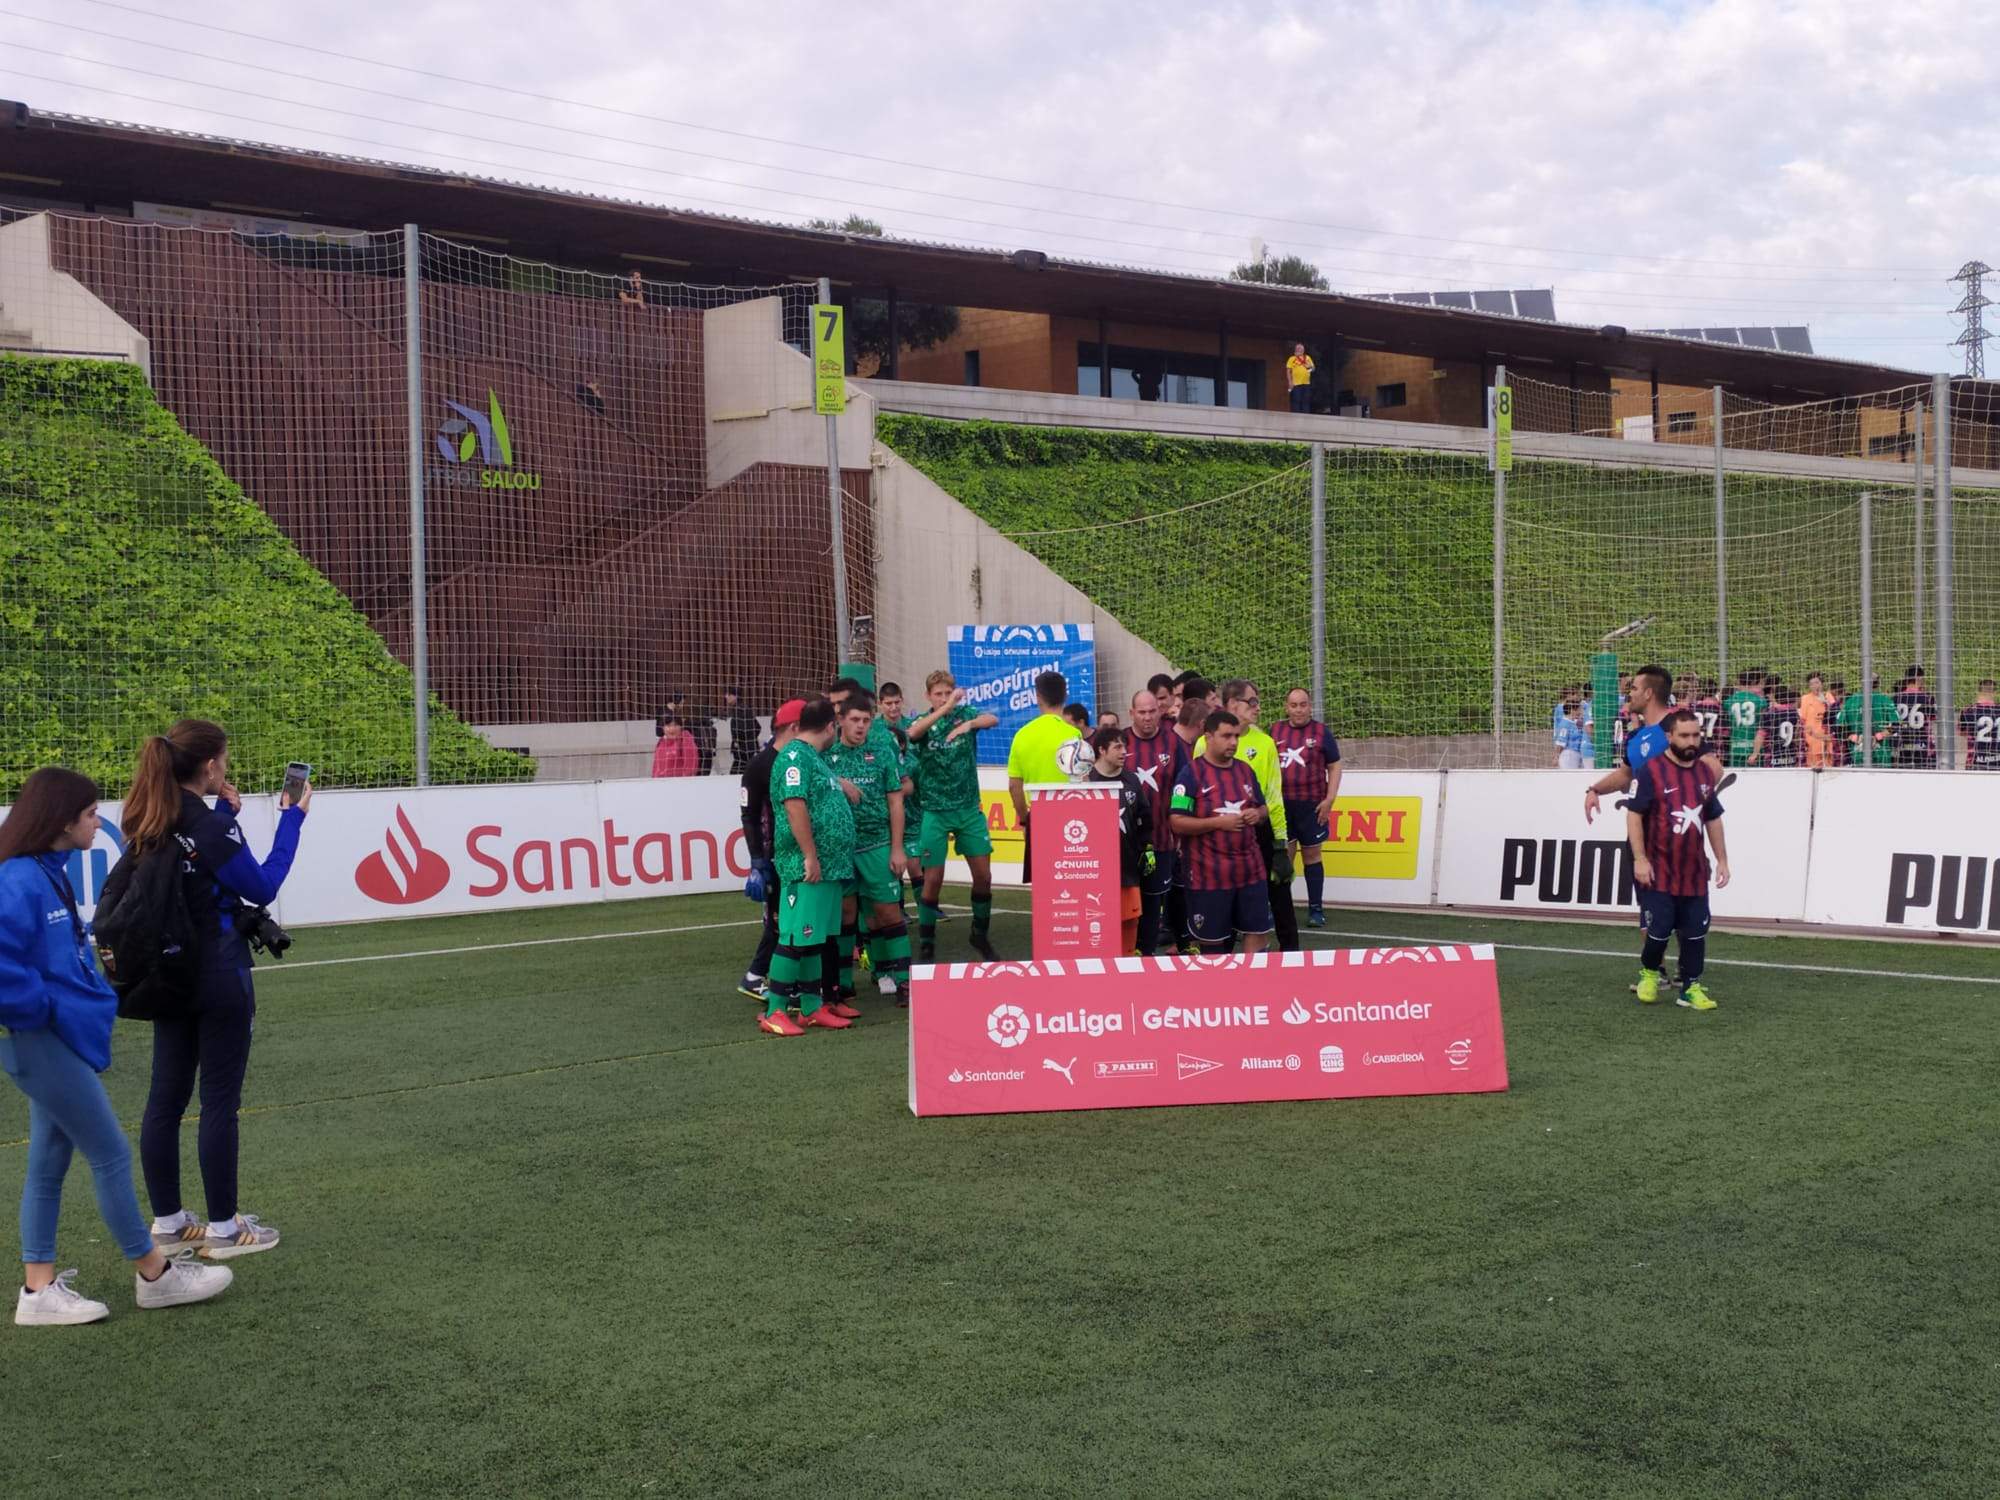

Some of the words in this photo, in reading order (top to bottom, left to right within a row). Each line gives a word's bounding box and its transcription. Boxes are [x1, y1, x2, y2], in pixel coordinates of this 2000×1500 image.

[819, 310, 838, 341] 7
[1500, 391, 1510, 415] 8
[481, 470, 541, 490] SALOU
[1731, 701, 1756, 728] 13
[1780, 721, 1794, 747] 9
[1328, 810, 1407, 843] INI
[466, 818, 752, 898] Santan
[1064, 845, 1088, 853] LaLiga
[1054, 860, 1099, 869] GENUINE
[1063, 872, 1099, 880] Santander
[1500, 838, 1635, 906] PUM
[1035, 1008, 1123, 1037] LaLiga
[1142, 1005, 1270, 1031] GENUINE
[1314, 1000, 1433, 1025] Santander
[965, 1068, 1025, 1082] Santander
[1111, 1062, 1155, 1073] PANINI
[1240, 1057, 1284, 1071] Allianz
[1320, 1059, 1344, 1068] KING
